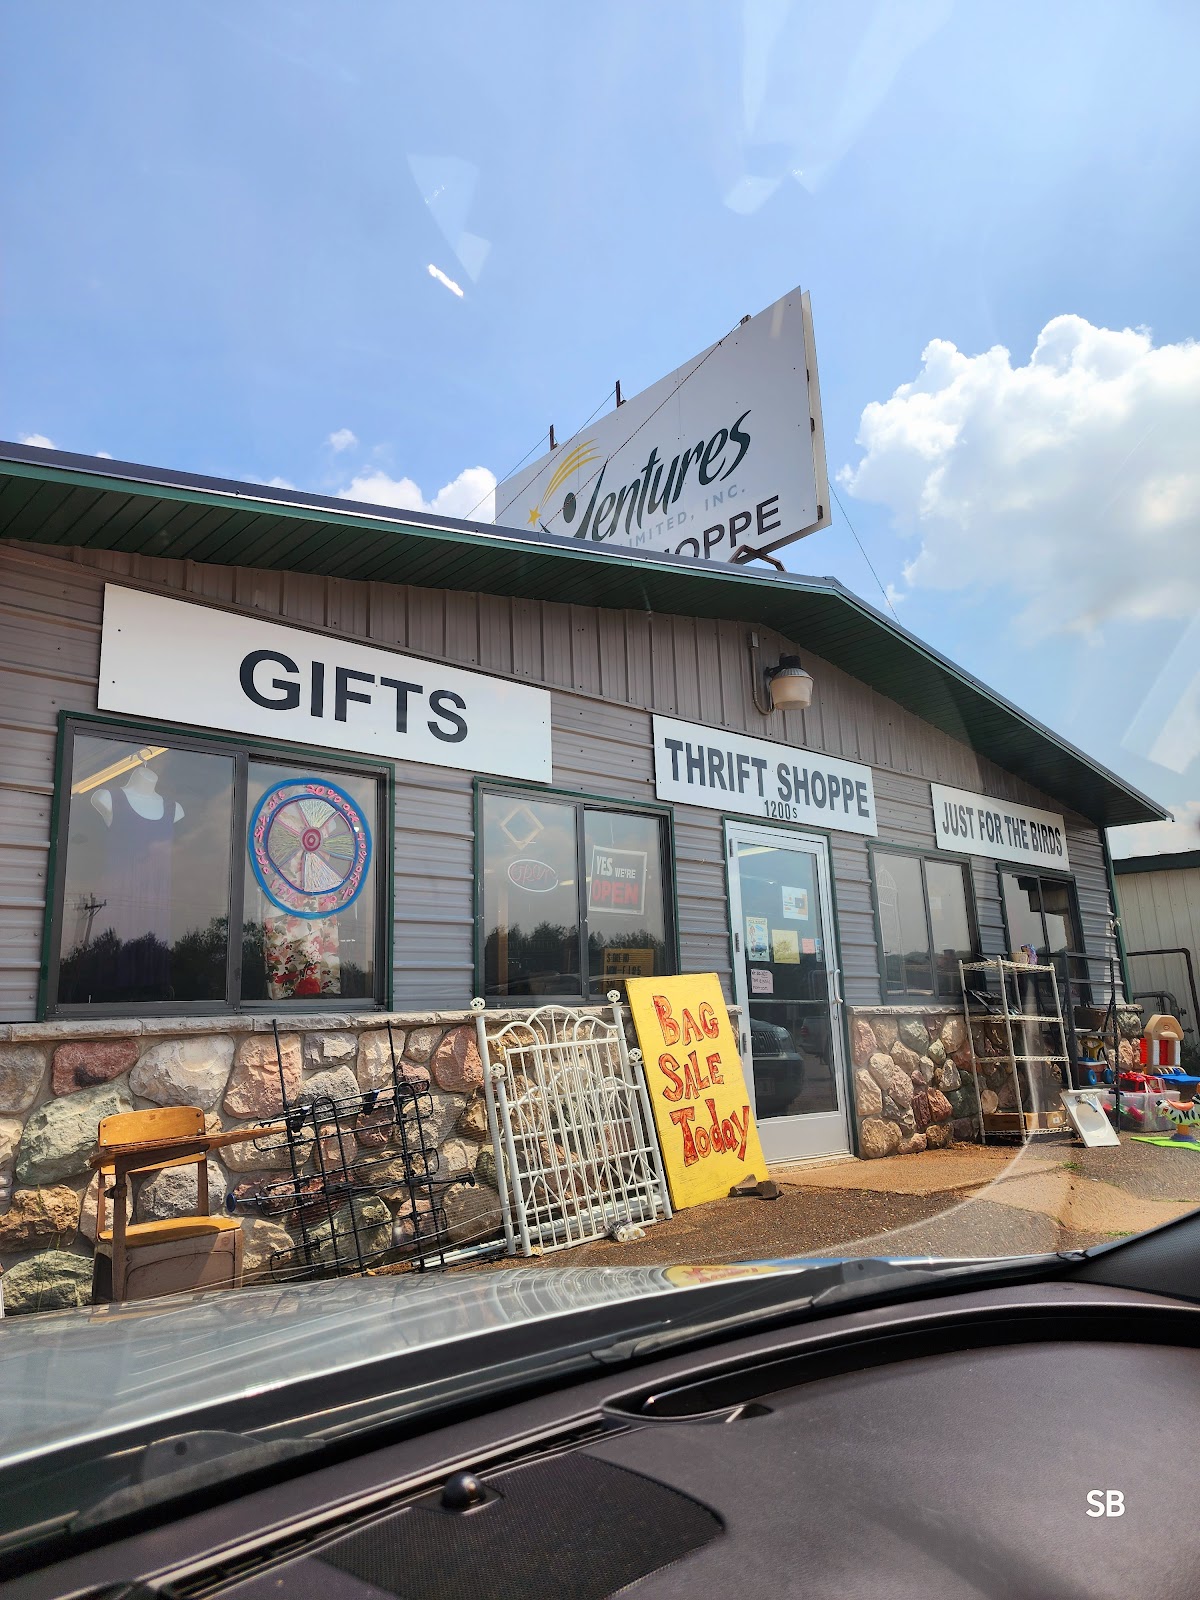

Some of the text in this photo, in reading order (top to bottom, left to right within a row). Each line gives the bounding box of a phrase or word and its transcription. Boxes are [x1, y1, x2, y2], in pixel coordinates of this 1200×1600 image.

[704, 484, 746, 511] INC.
[239, 650, 469, 743] GIFTS
[664, 737, 870, 818] THRIFT SHOPPE
[942, 801, 1063, 857] JUST FOR THE BIRDS
[592, 879, 639, 906] OPEN
[597, 855, 636, 879] YES WE'RE
[652, 995, 720, 1046] BAG
[658, 1050, 725, 1102] SALE
[669, 1098, 750, 1168] Today
